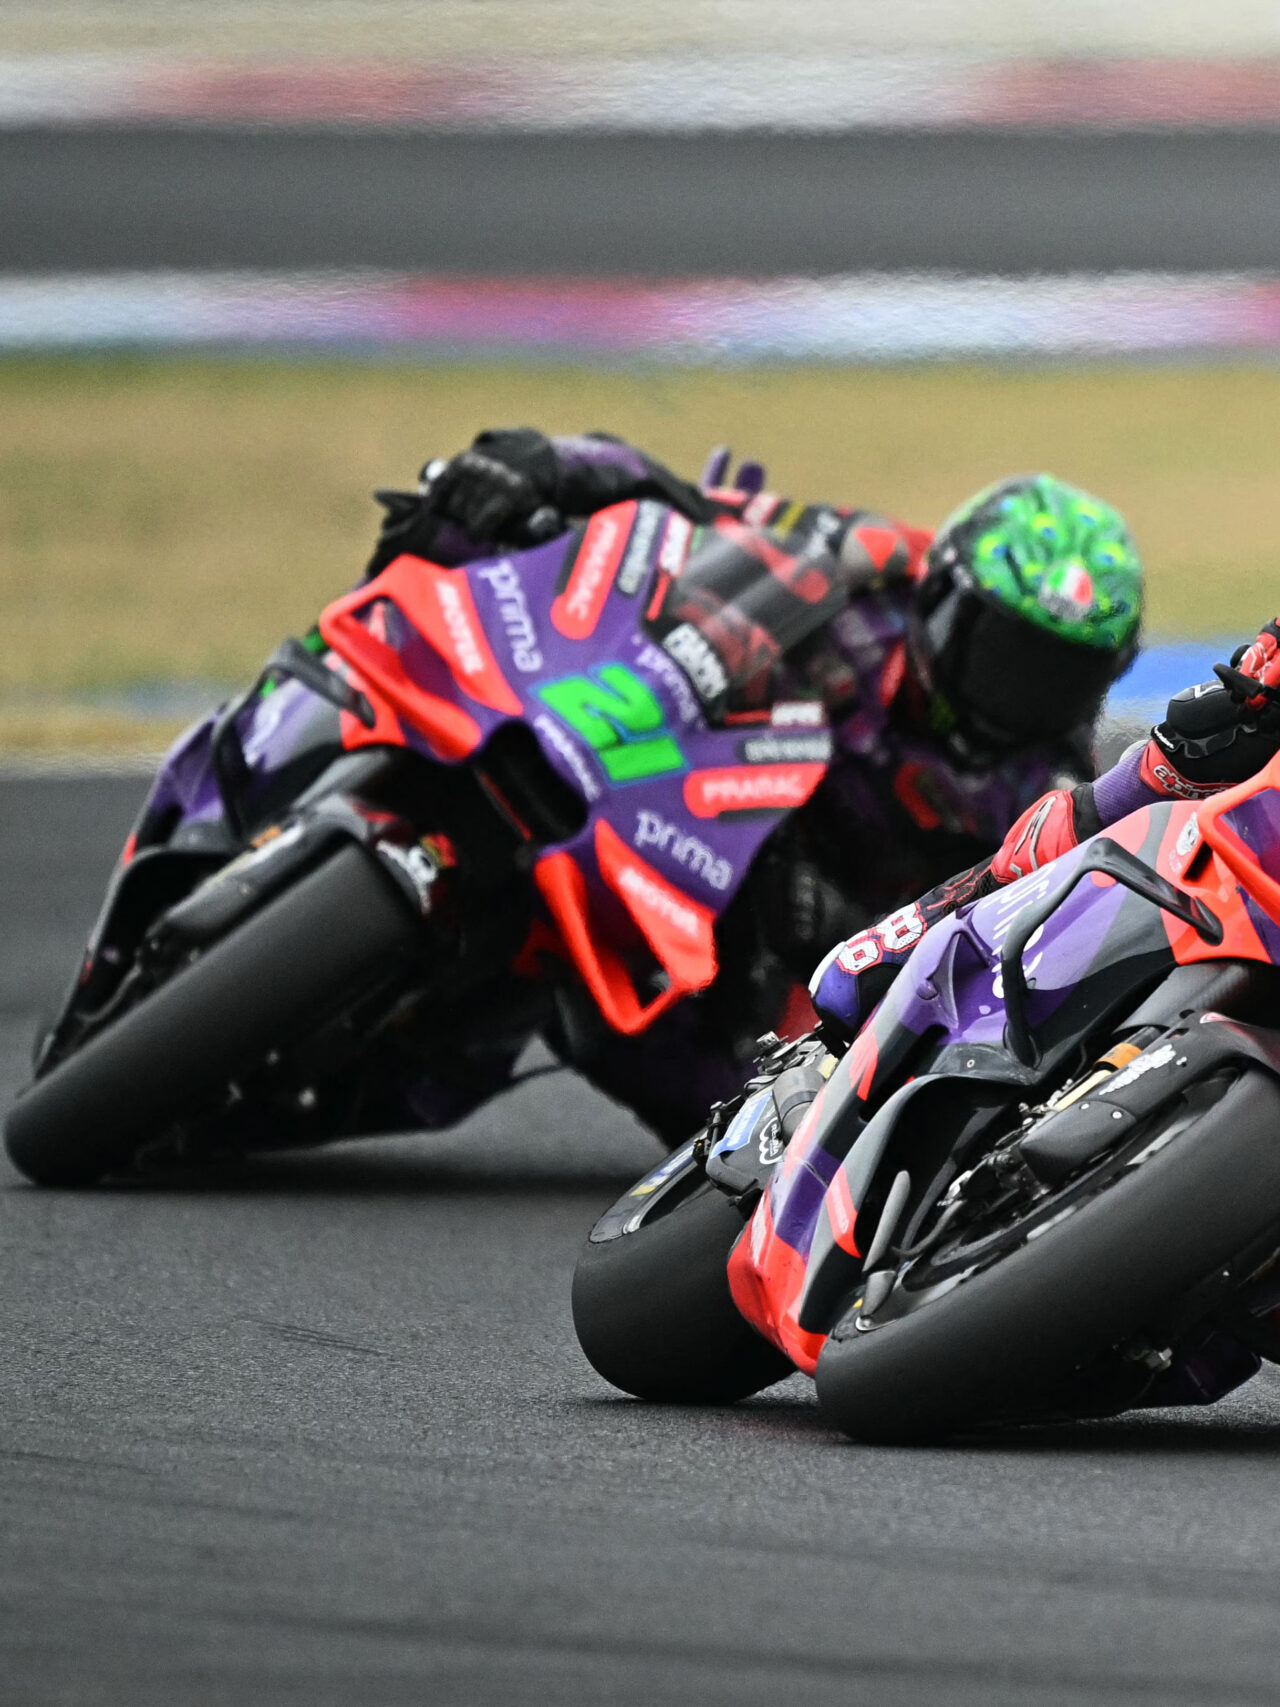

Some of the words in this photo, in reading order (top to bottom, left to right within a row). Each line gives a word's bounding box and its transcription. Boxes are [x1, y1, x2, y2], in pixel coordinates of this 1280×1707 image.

[479, 559, 543, 673] prima
[539, 664, 684, 781] 21
[635, 810, 733, 890] prima
